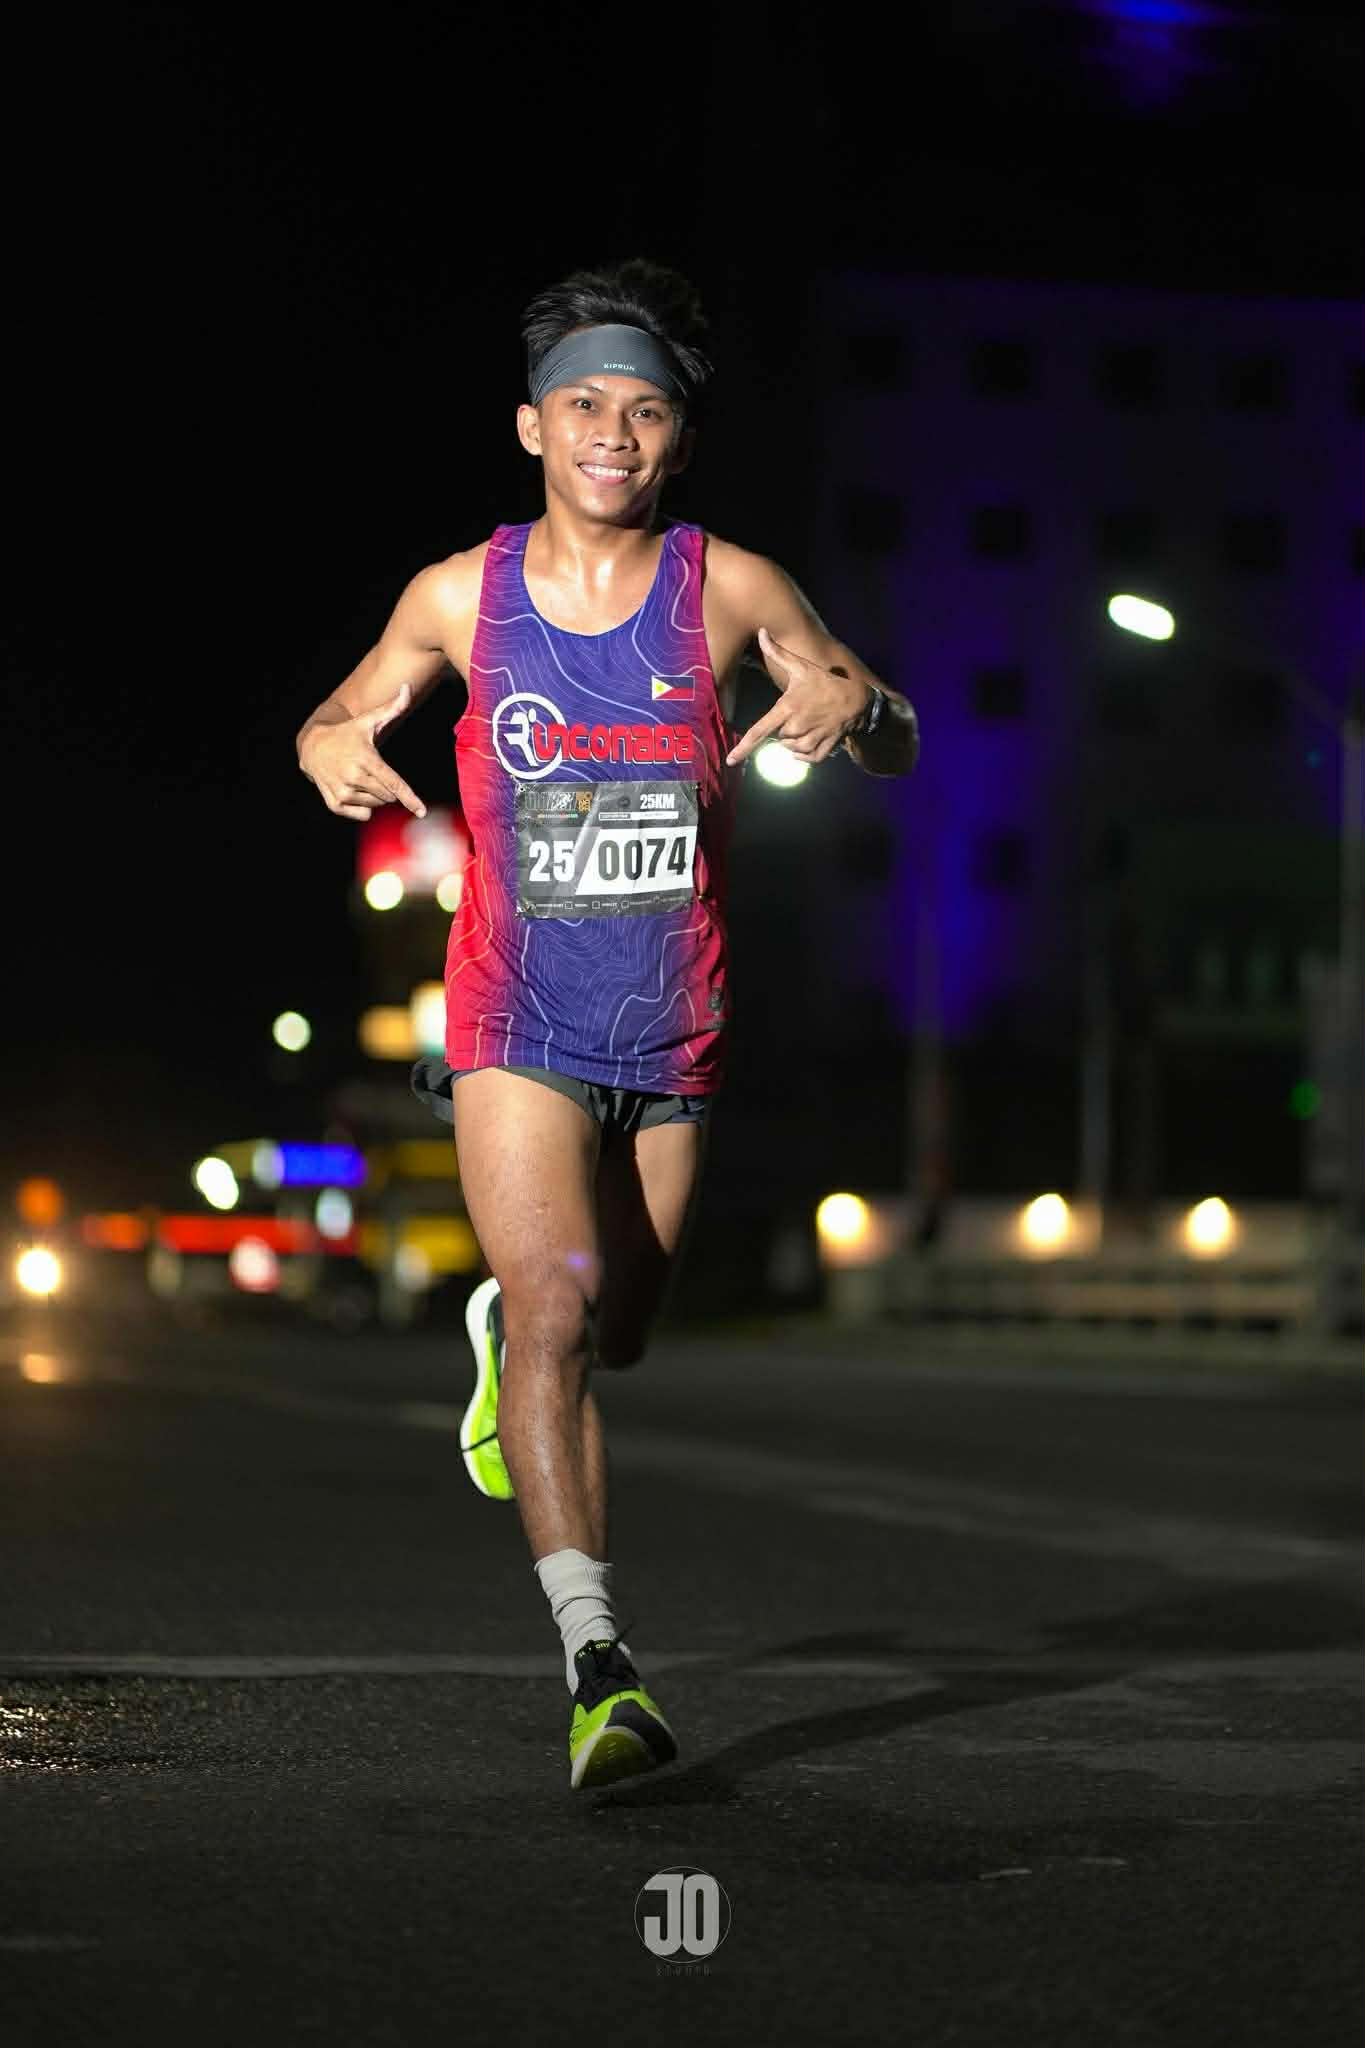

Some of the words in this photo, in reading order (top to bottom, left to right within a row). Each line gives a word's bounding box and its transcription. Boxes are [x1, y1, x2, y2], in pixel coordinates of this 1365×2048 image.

[640, 793, 675, 809] 25KM
[528, 840, 575, 882] 25
[598, 836, 687, 880] 0074
